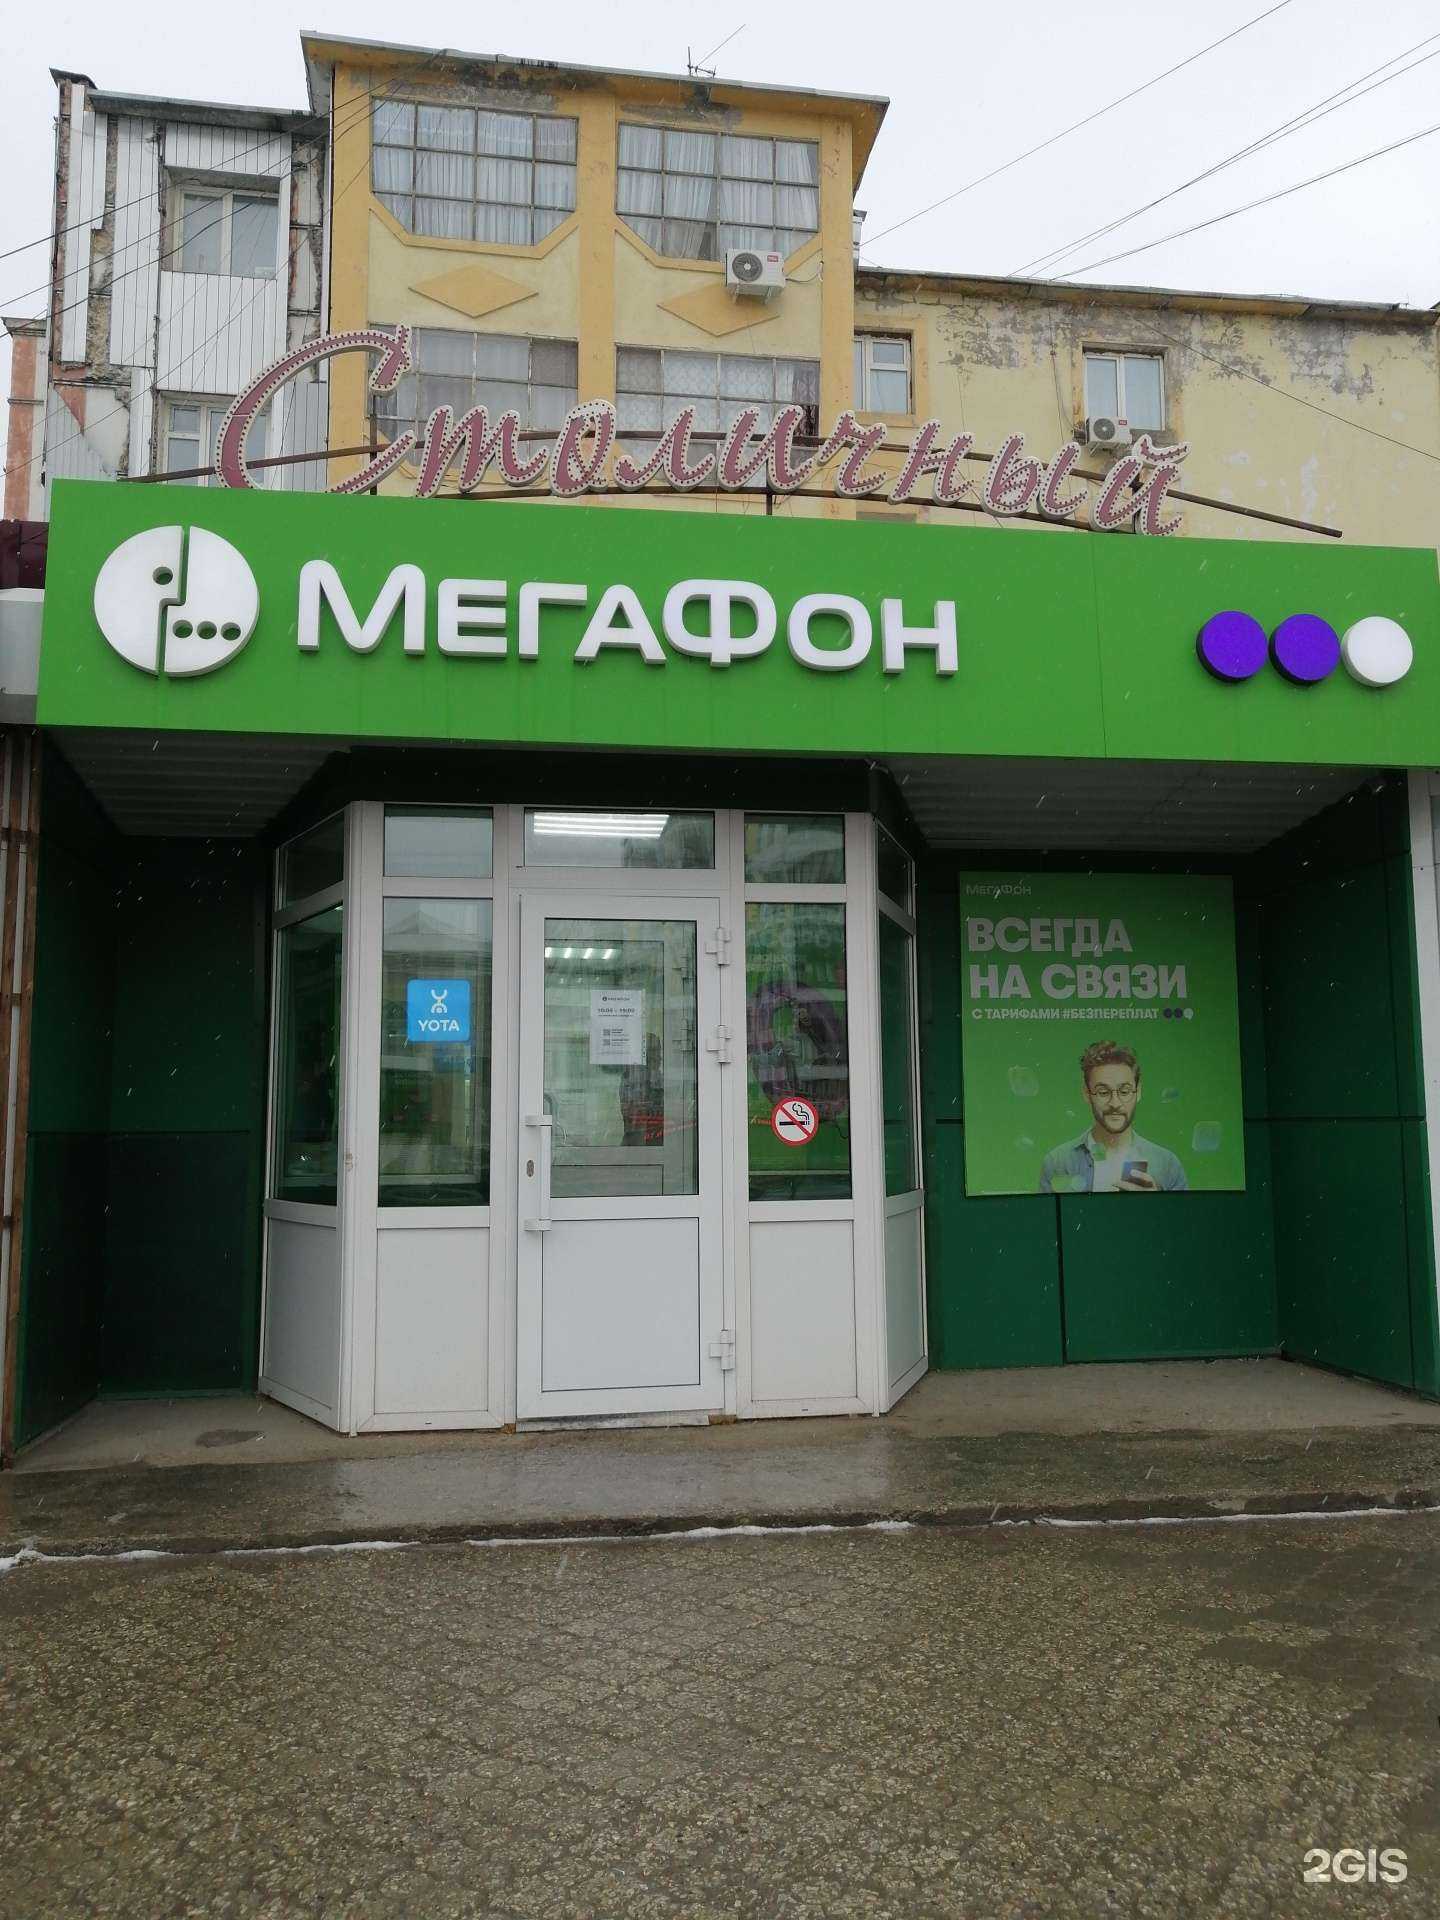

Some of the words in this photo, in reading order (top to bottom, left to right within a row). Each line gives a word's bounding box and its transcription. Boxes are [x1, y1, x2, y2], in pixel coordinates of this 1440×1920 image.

[215, 324, 1191, 537] Столичный
[297, 559, 958, 675] МЕГАФОН
[968, 916, 1133, 957] ВСЕГДА
[969, 964, 1032, 999] НА
[1041, 963, 1188, 1000] СВЯЗИ
[418, 1019, 461, 1032] YOTA
[972, 1008, 983, 1020] С
[985, 1008, 1061, 1020] ТАРИФАМИ
[1062, 1008, 1159, 1020] #БЕЗПЕРЕПЛАТ
